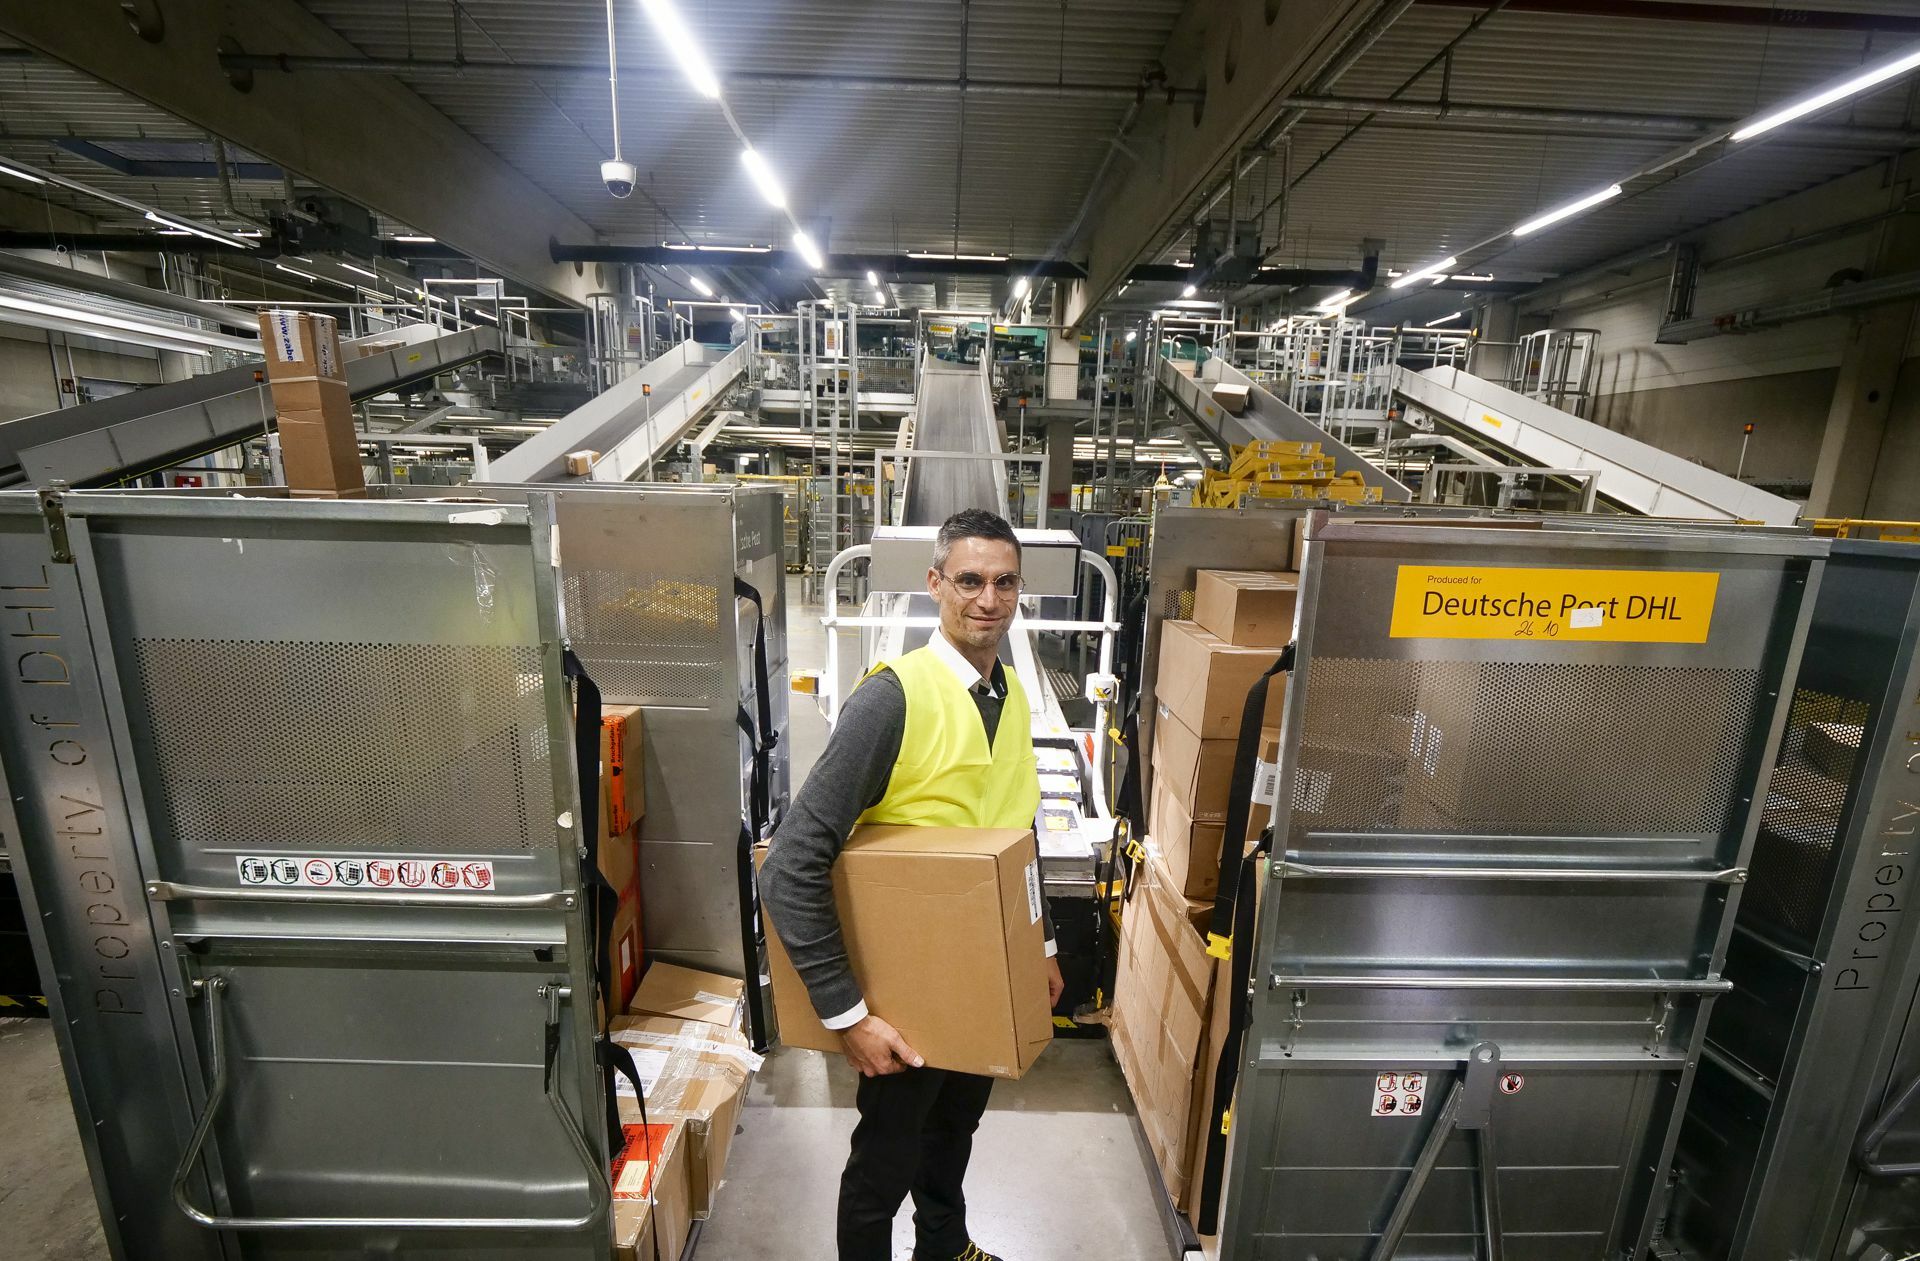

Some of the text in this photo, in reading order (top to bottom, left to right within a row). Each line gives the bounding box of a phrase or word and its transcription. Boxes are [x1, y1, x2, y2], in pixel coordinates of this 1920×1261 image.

[1423, 591, 1551, 617] Deutsche
[1626, 596, 1681, 620] DHL
[1427, 575, 1482, 584] Produced for
[0, 565, 143, 1014] Property of DHL
[1834, 800, 1920, 991] Property
